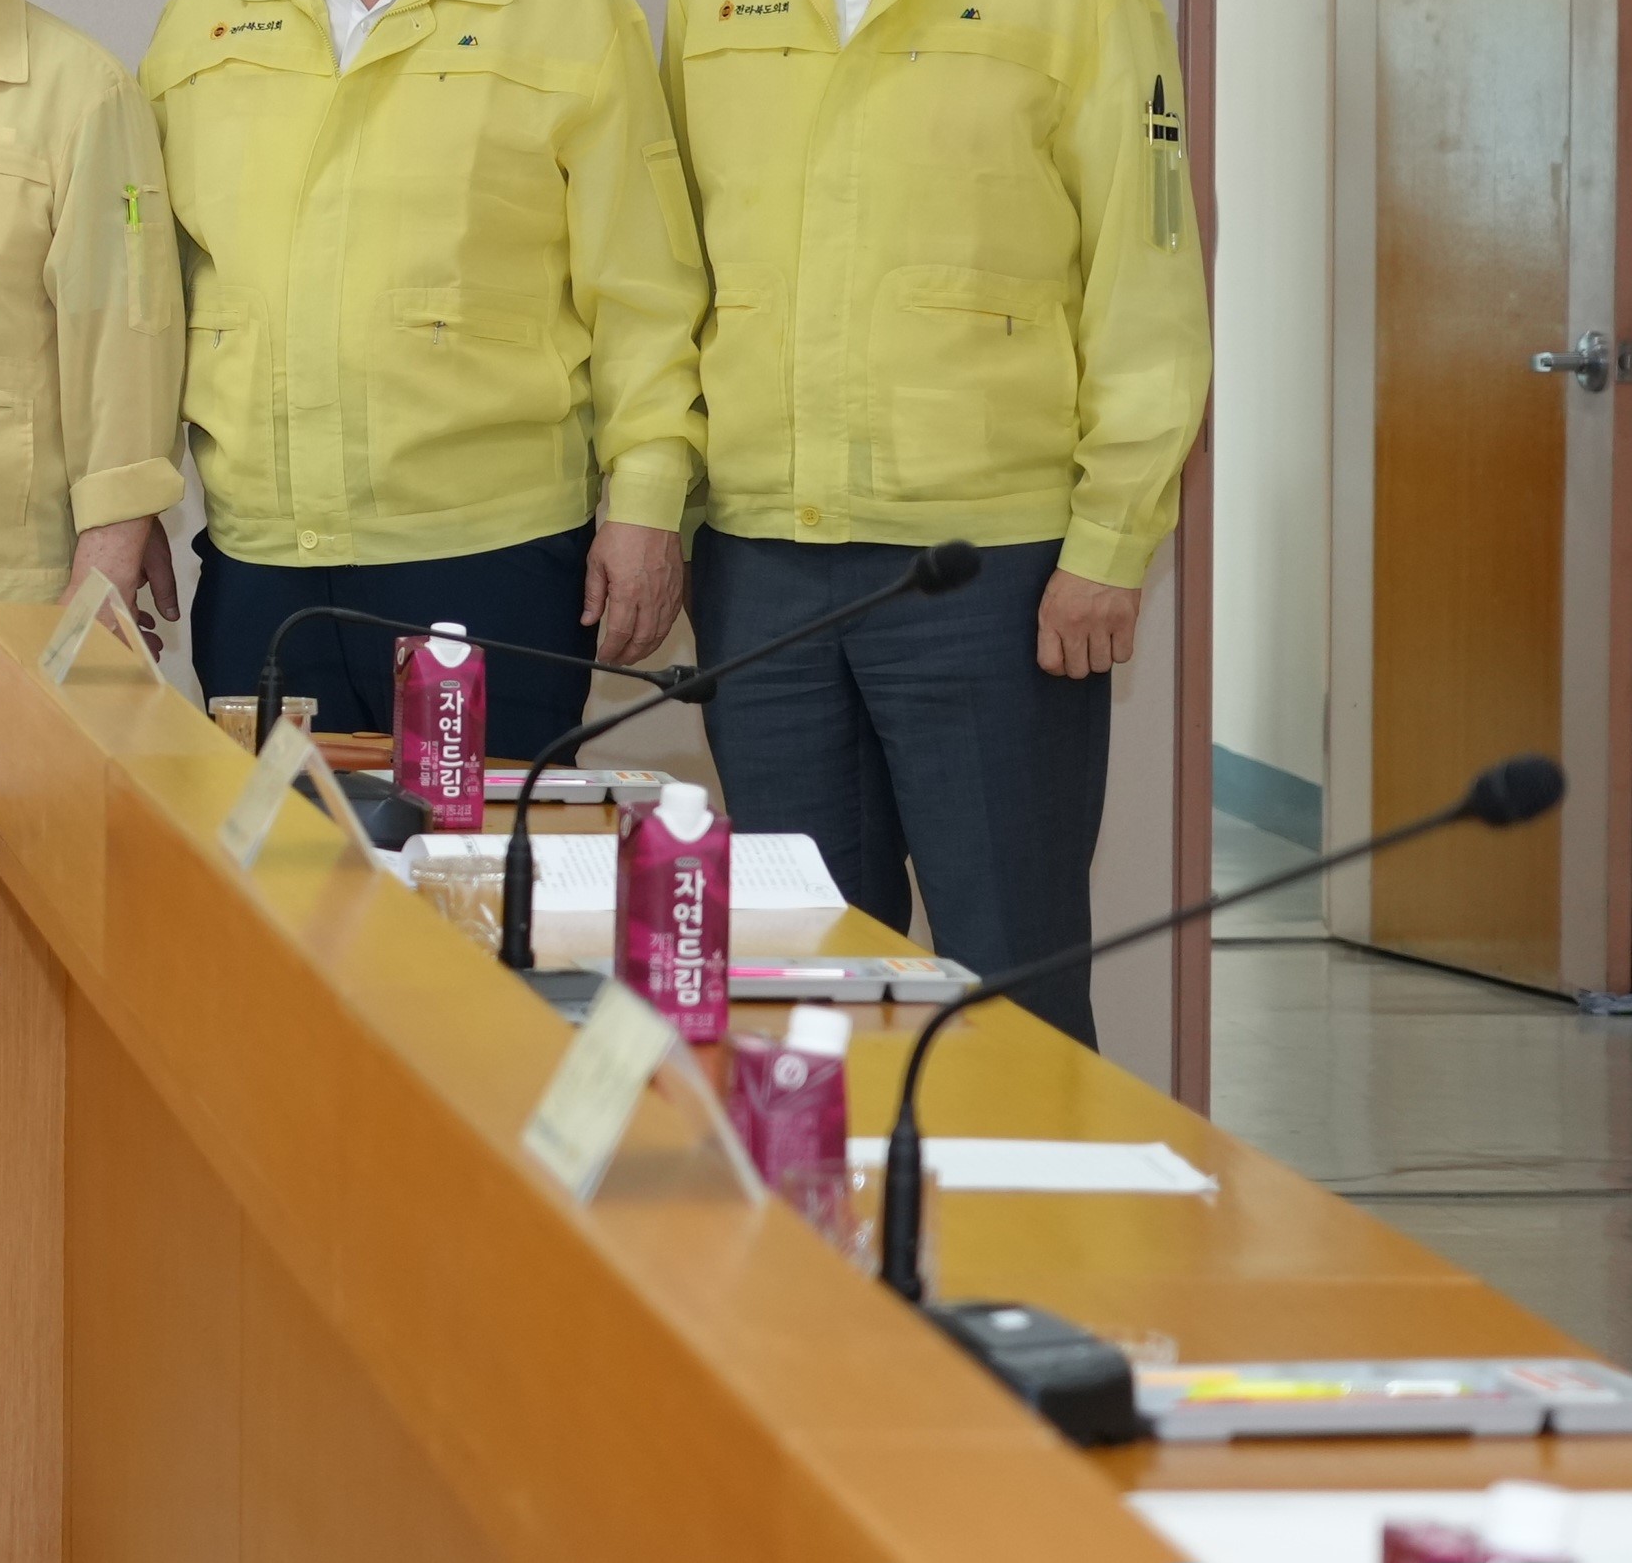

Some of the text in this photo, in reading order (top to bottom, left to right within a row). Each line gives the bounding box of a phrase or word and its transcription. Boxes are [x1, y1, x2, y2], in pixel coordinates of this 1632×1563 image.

[734, 1, 790, 16] 전라북도의회
[439, 690, 465, 798] 자연드림
[673, 869, 707, 1006] 자연드림
